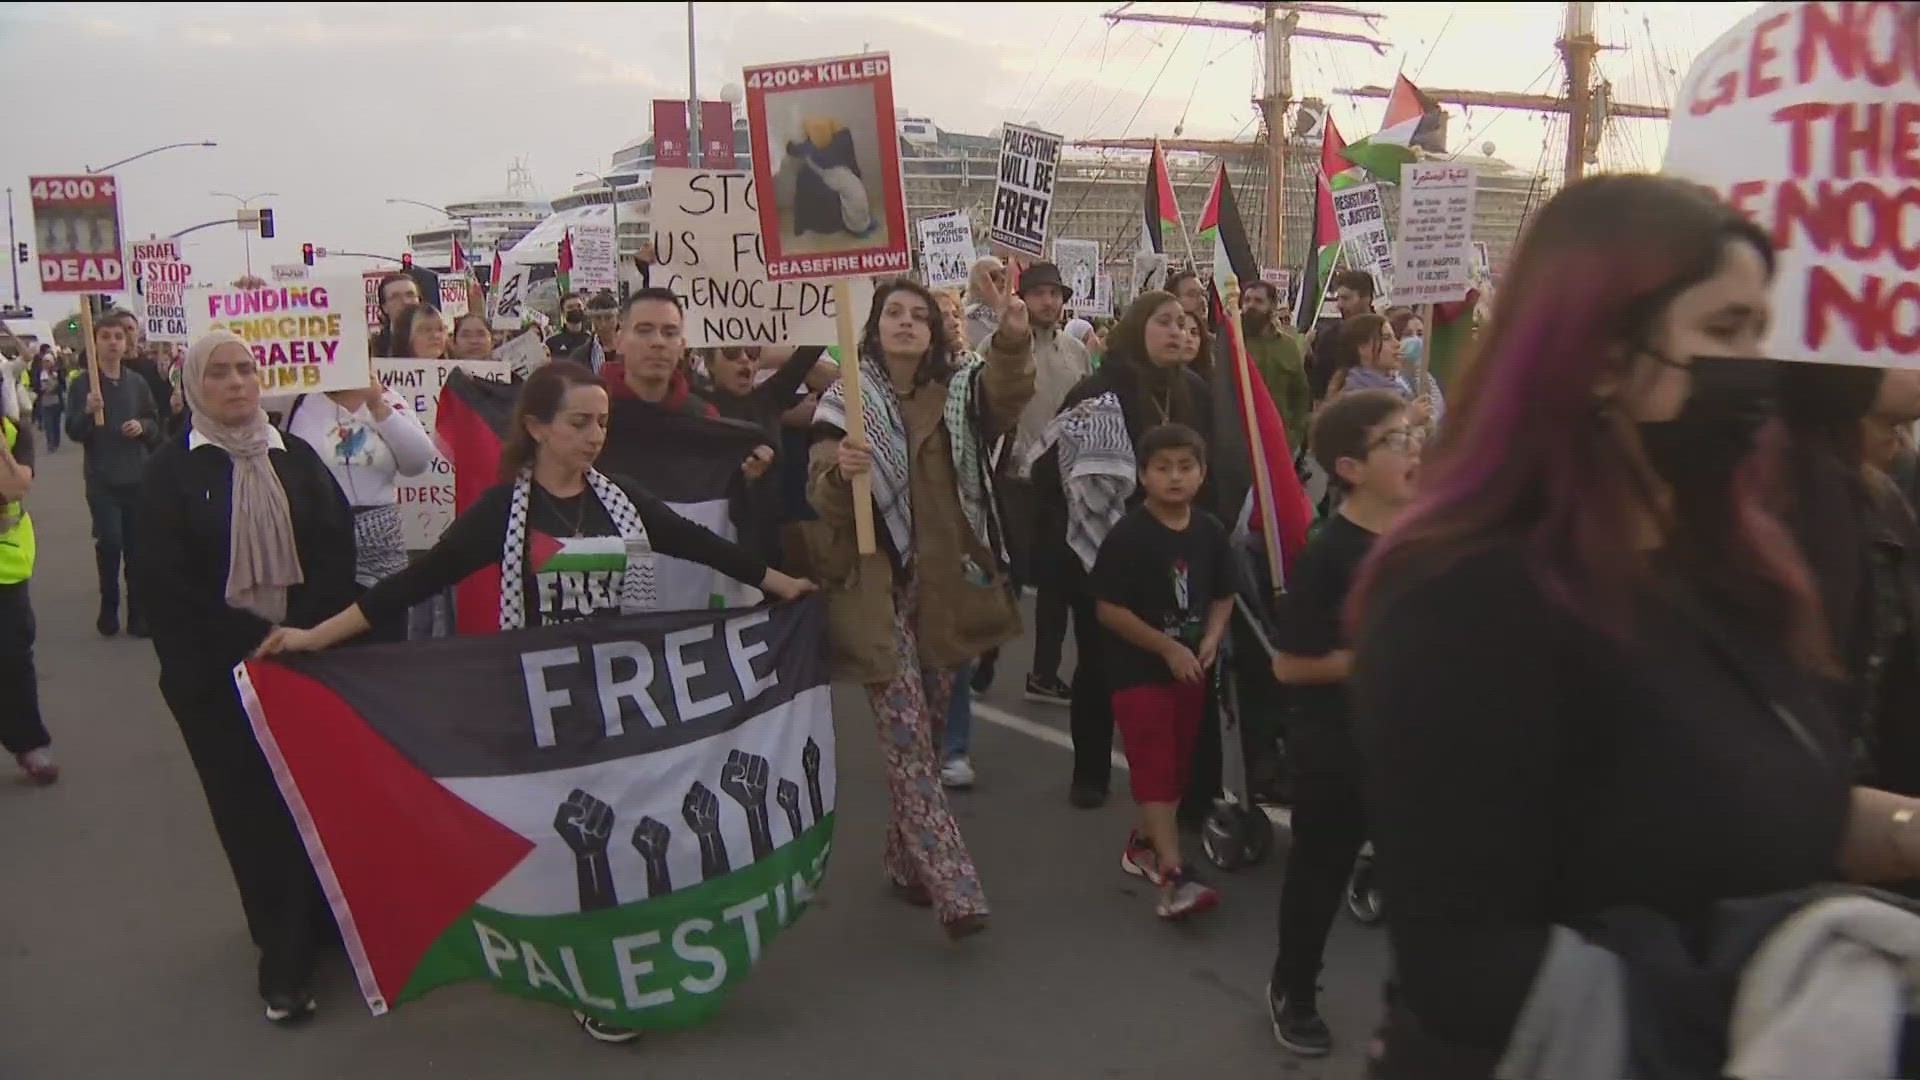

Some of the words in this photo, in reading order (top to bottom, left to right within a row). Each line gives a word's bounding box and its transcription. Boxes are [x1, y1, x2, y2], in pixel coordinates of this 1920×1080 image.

[747, 73, 815, 88] 4200+
[817, 59, 889, 82] KILLED
[1002, 129, 1059, 163] PALESTINE
[1001, 152, 1029, 188] WILL
[1033, 161, 1054, 193] BE
[32, 180, 96, 200] 4200
[993, 186, 1049, 241] FREE!
[1730, 180, 1920, 271] ENOC
[654, 231, 700, 266] US
[41, 259, 122, 282] DEAD
[147, 262, 192, 284] STOP
[767, 257, 862, 276] CEASEFIRE
[862, 252, 908, 268] NOW!
[208, 287, 328, 318] FUNDING
[668, 274, 837, 318] GENOCIDE
[147, 305, 184, 318] GENOCI
[148, 319, 163, 334] OF
[167, 319, 187, 334] GA
[208, 313, 341, 342] ENOCIDE
[704, 312, 789, 344] NOW!
[251, 340, 339, 366] RAELY
[377, 368, 425, 388] WHAT
[431, 456, 457, 474] YO
[397, 485, 457, 506] IDERS
[520, 611, 778, 748] FREE
